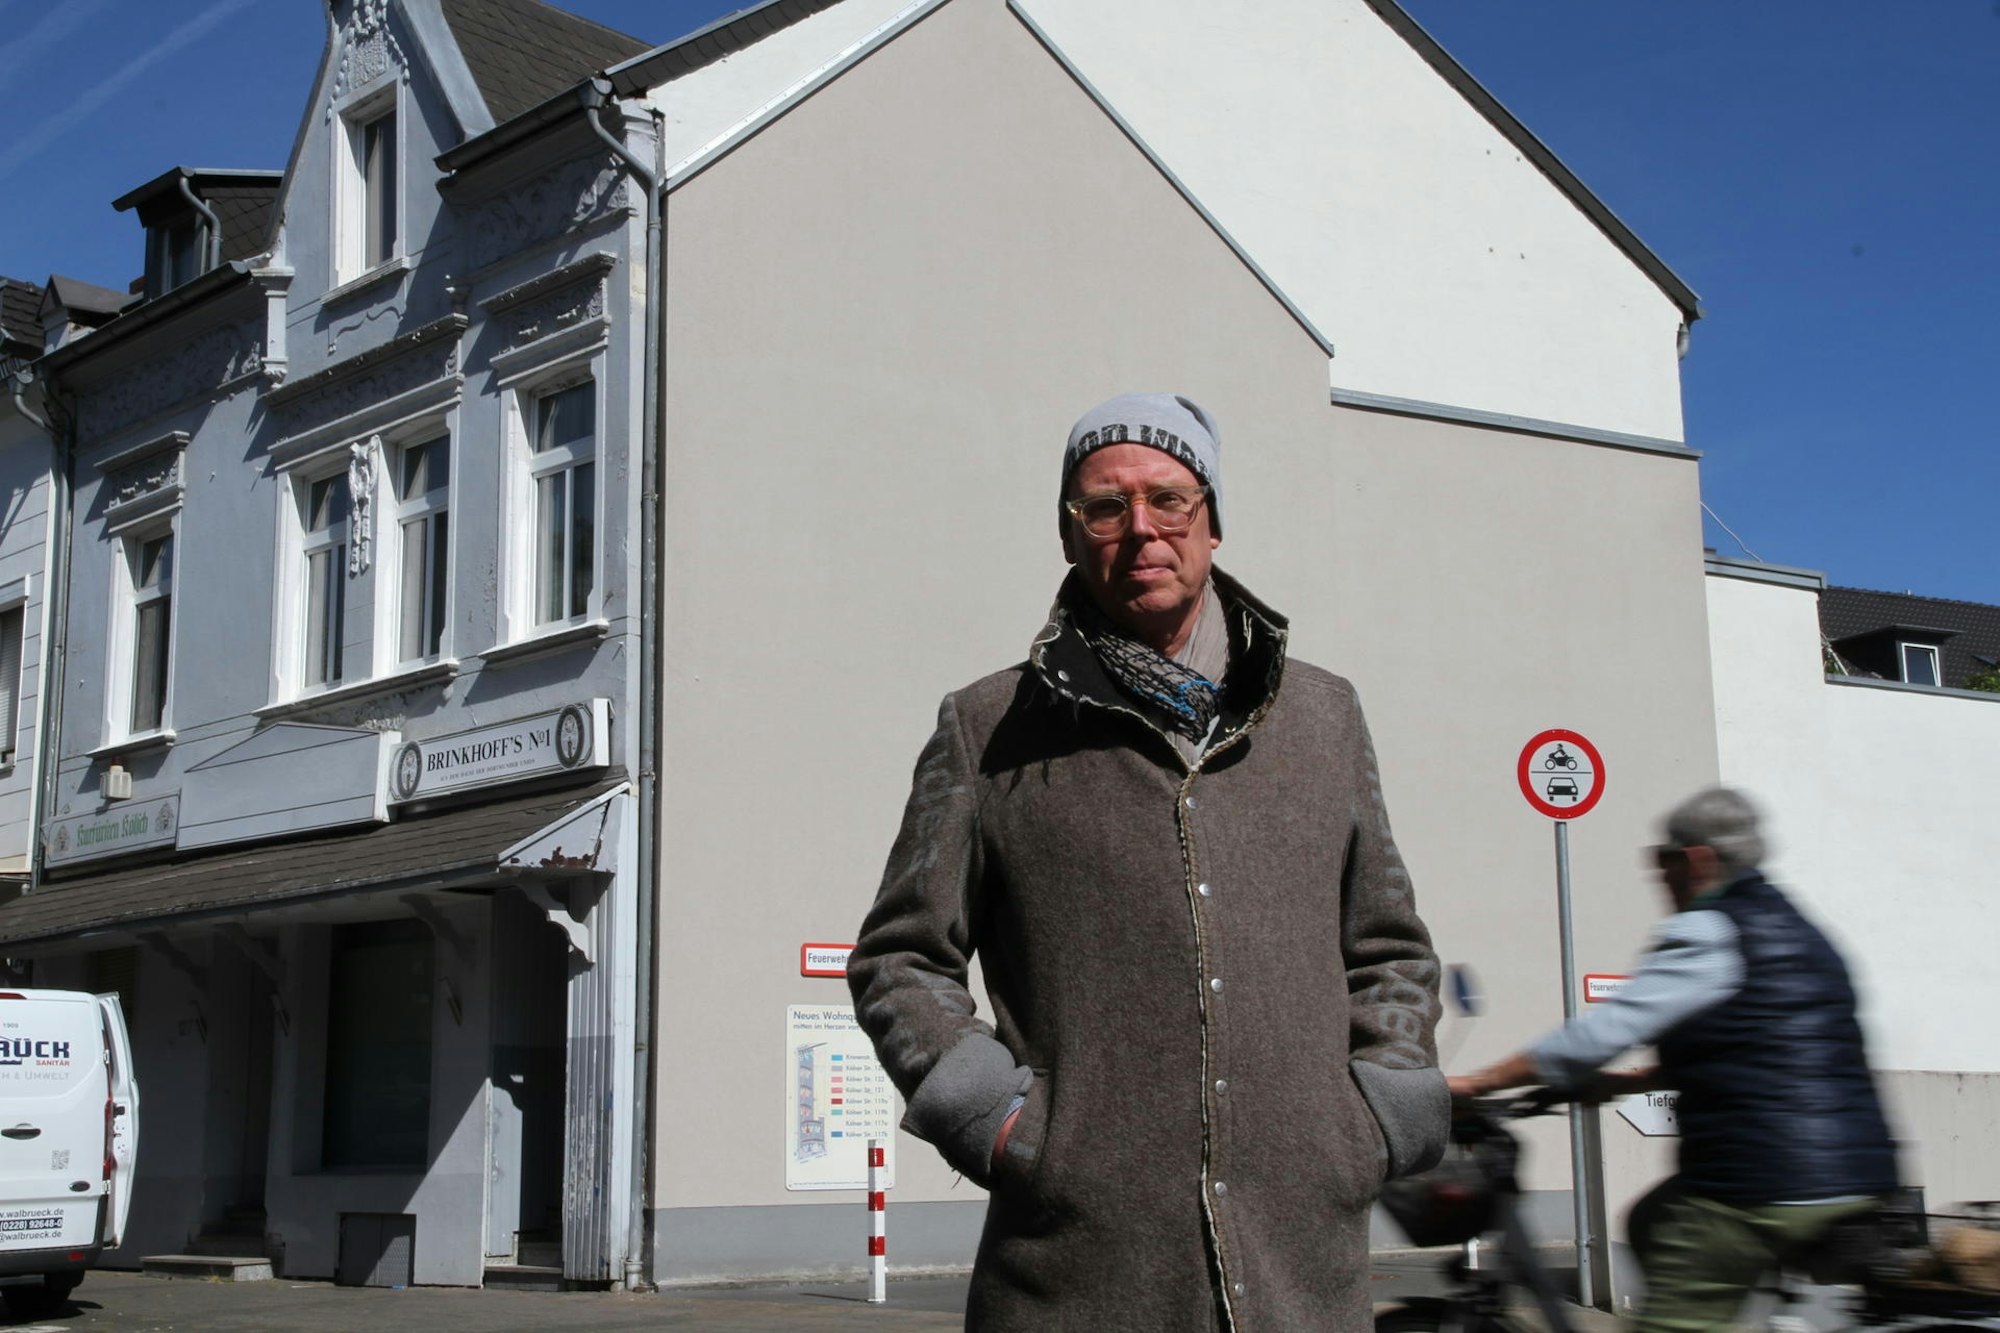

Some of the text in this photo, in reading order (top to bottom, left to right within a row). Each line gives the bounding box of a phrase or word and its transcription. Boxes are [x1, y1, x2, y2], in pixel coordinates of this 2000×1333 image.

[427, 734, 523, 772] BRINKHOFF'S
[793, 1011, 820, 1020] Neues
[824, 1022, 846, 1030] Herzen
[25, 1071, 70, 1080] UMWELT
[1, 1219, 62, 1230] (0228) 92648-0
